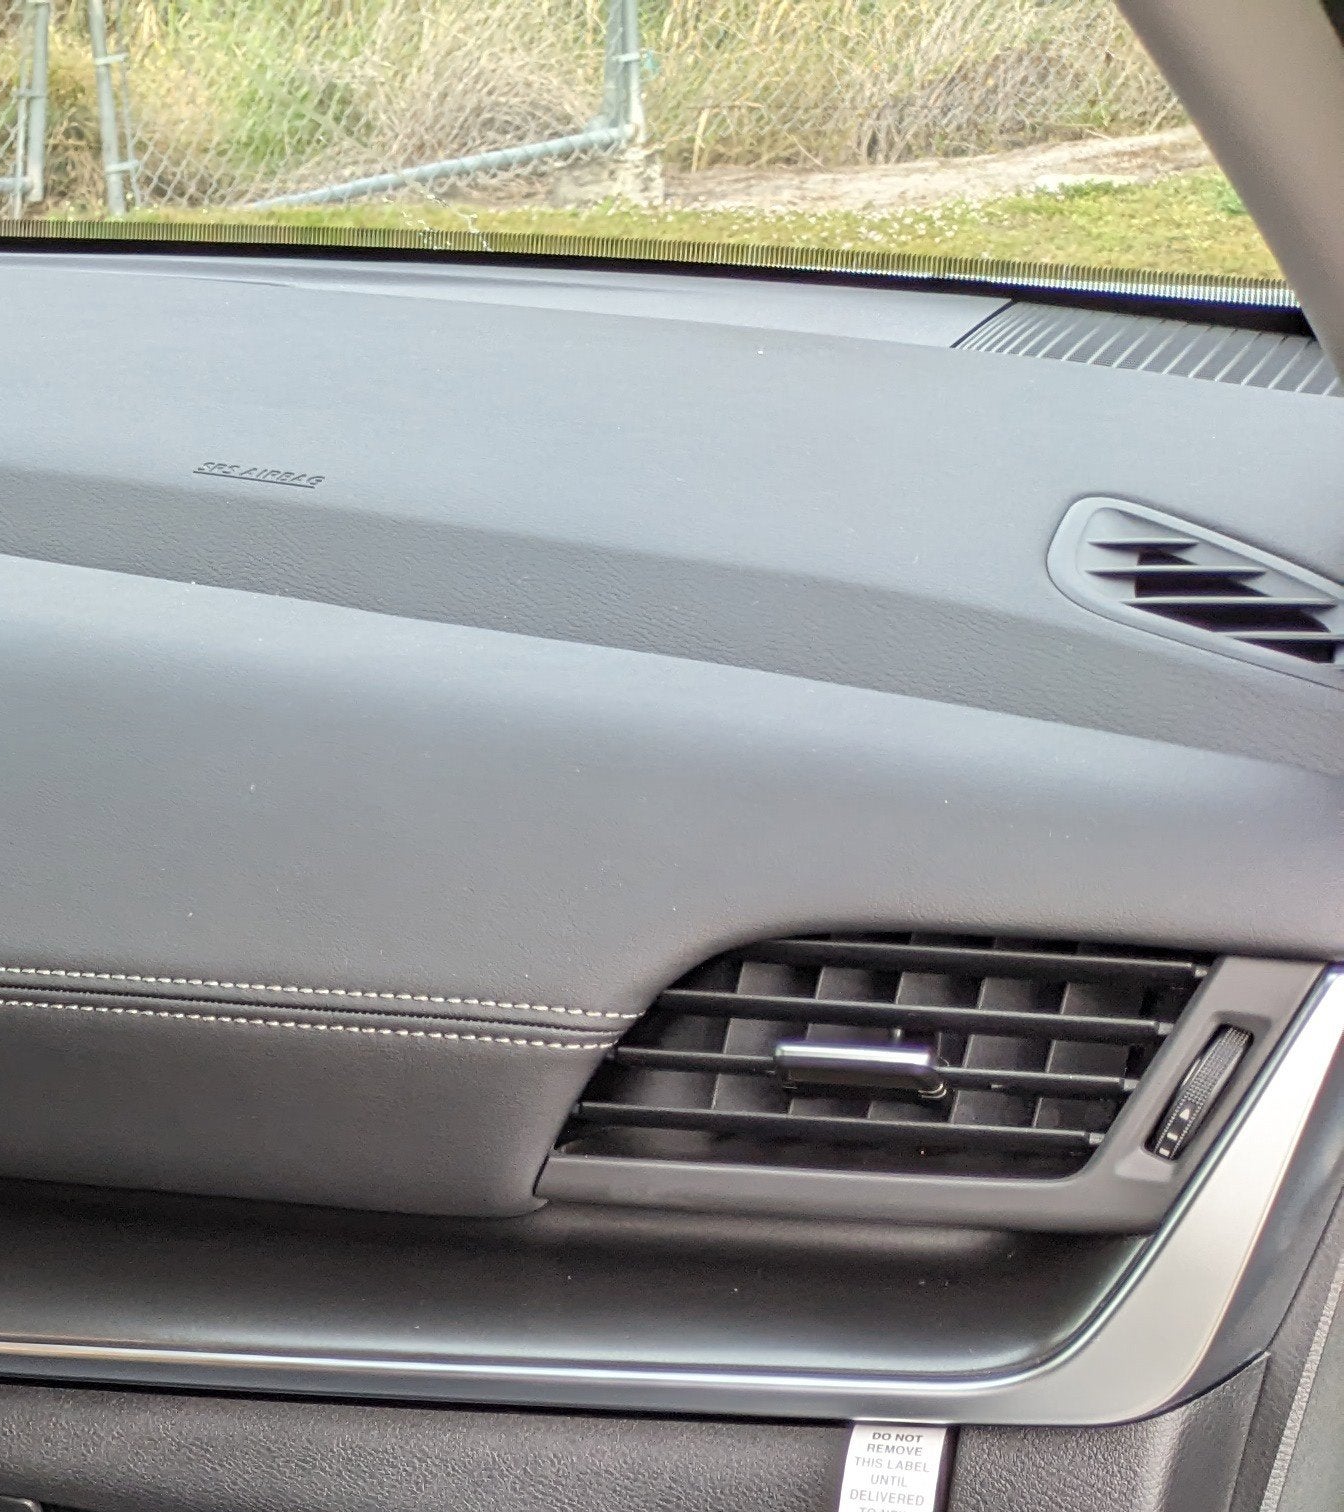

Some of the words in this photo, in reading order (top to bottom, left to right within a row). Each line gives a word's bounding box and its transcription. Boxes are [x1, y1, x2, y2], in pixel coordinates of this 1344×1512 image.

[240, 467, 325, 486] AIRBAG
[872, 1431, 892, 1441] DO
[895, 1433, 923, 1443] NOT
[867, 1443, 923, 1456] REMOVE
[855, 1456, 882, 1469] THIS
[887, 1459, 930, 1472] LABEL
[870, 1474, 908, 1487] UNTIL
[849, 1489, 924, 1506] DELIVERED
